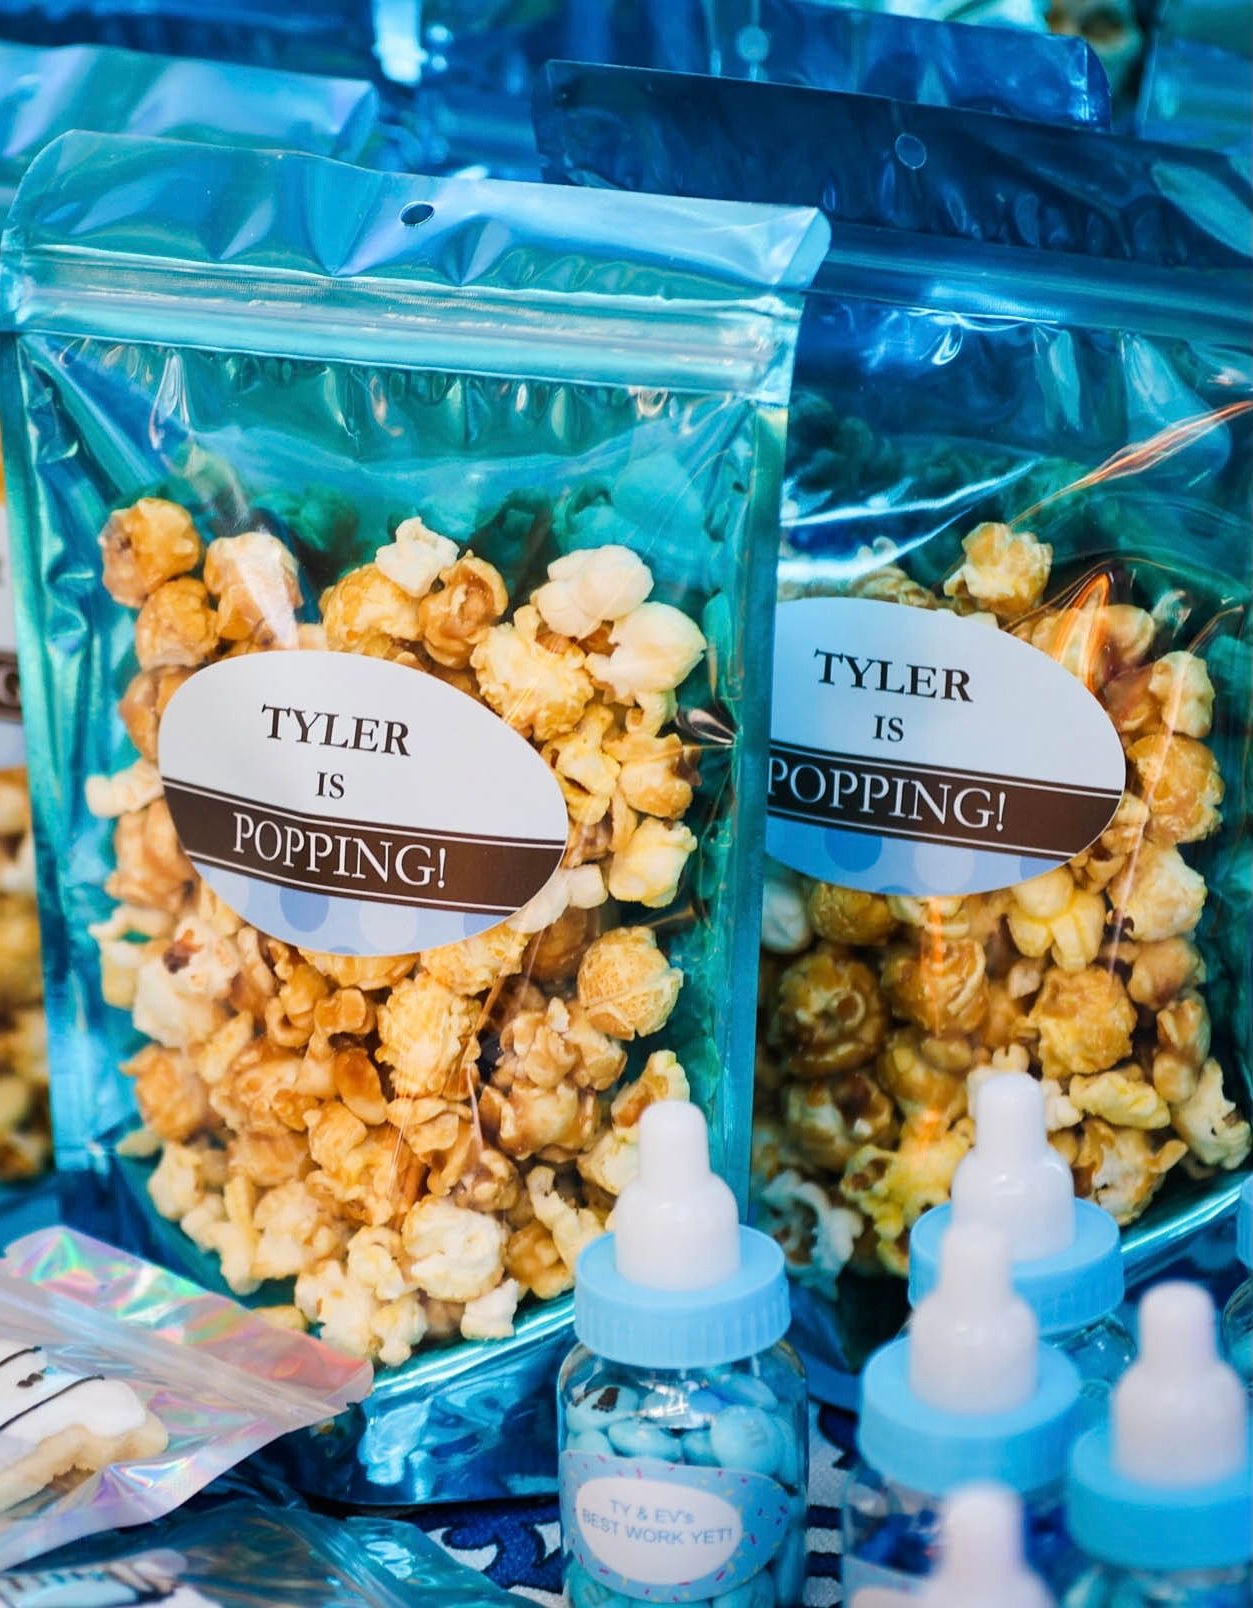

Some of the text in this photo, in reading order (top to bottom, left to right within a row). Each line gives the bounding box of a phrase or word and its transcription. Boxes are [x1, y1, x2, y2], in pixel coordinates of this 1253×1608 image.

[813, 648, 974, 703] TYLER
[261, 703, 412, 757] TYLER
[872, 715, 905, 743] IS
[315, 771, 346, 800] IS
[768, 756, 1007, 833] POPPING!
[232, 812, 448, 889] POPPING!
[581, 1508, 733, 1545] BEST WORK YET!
[610, 1499, 694, 1525] TY & EV's
